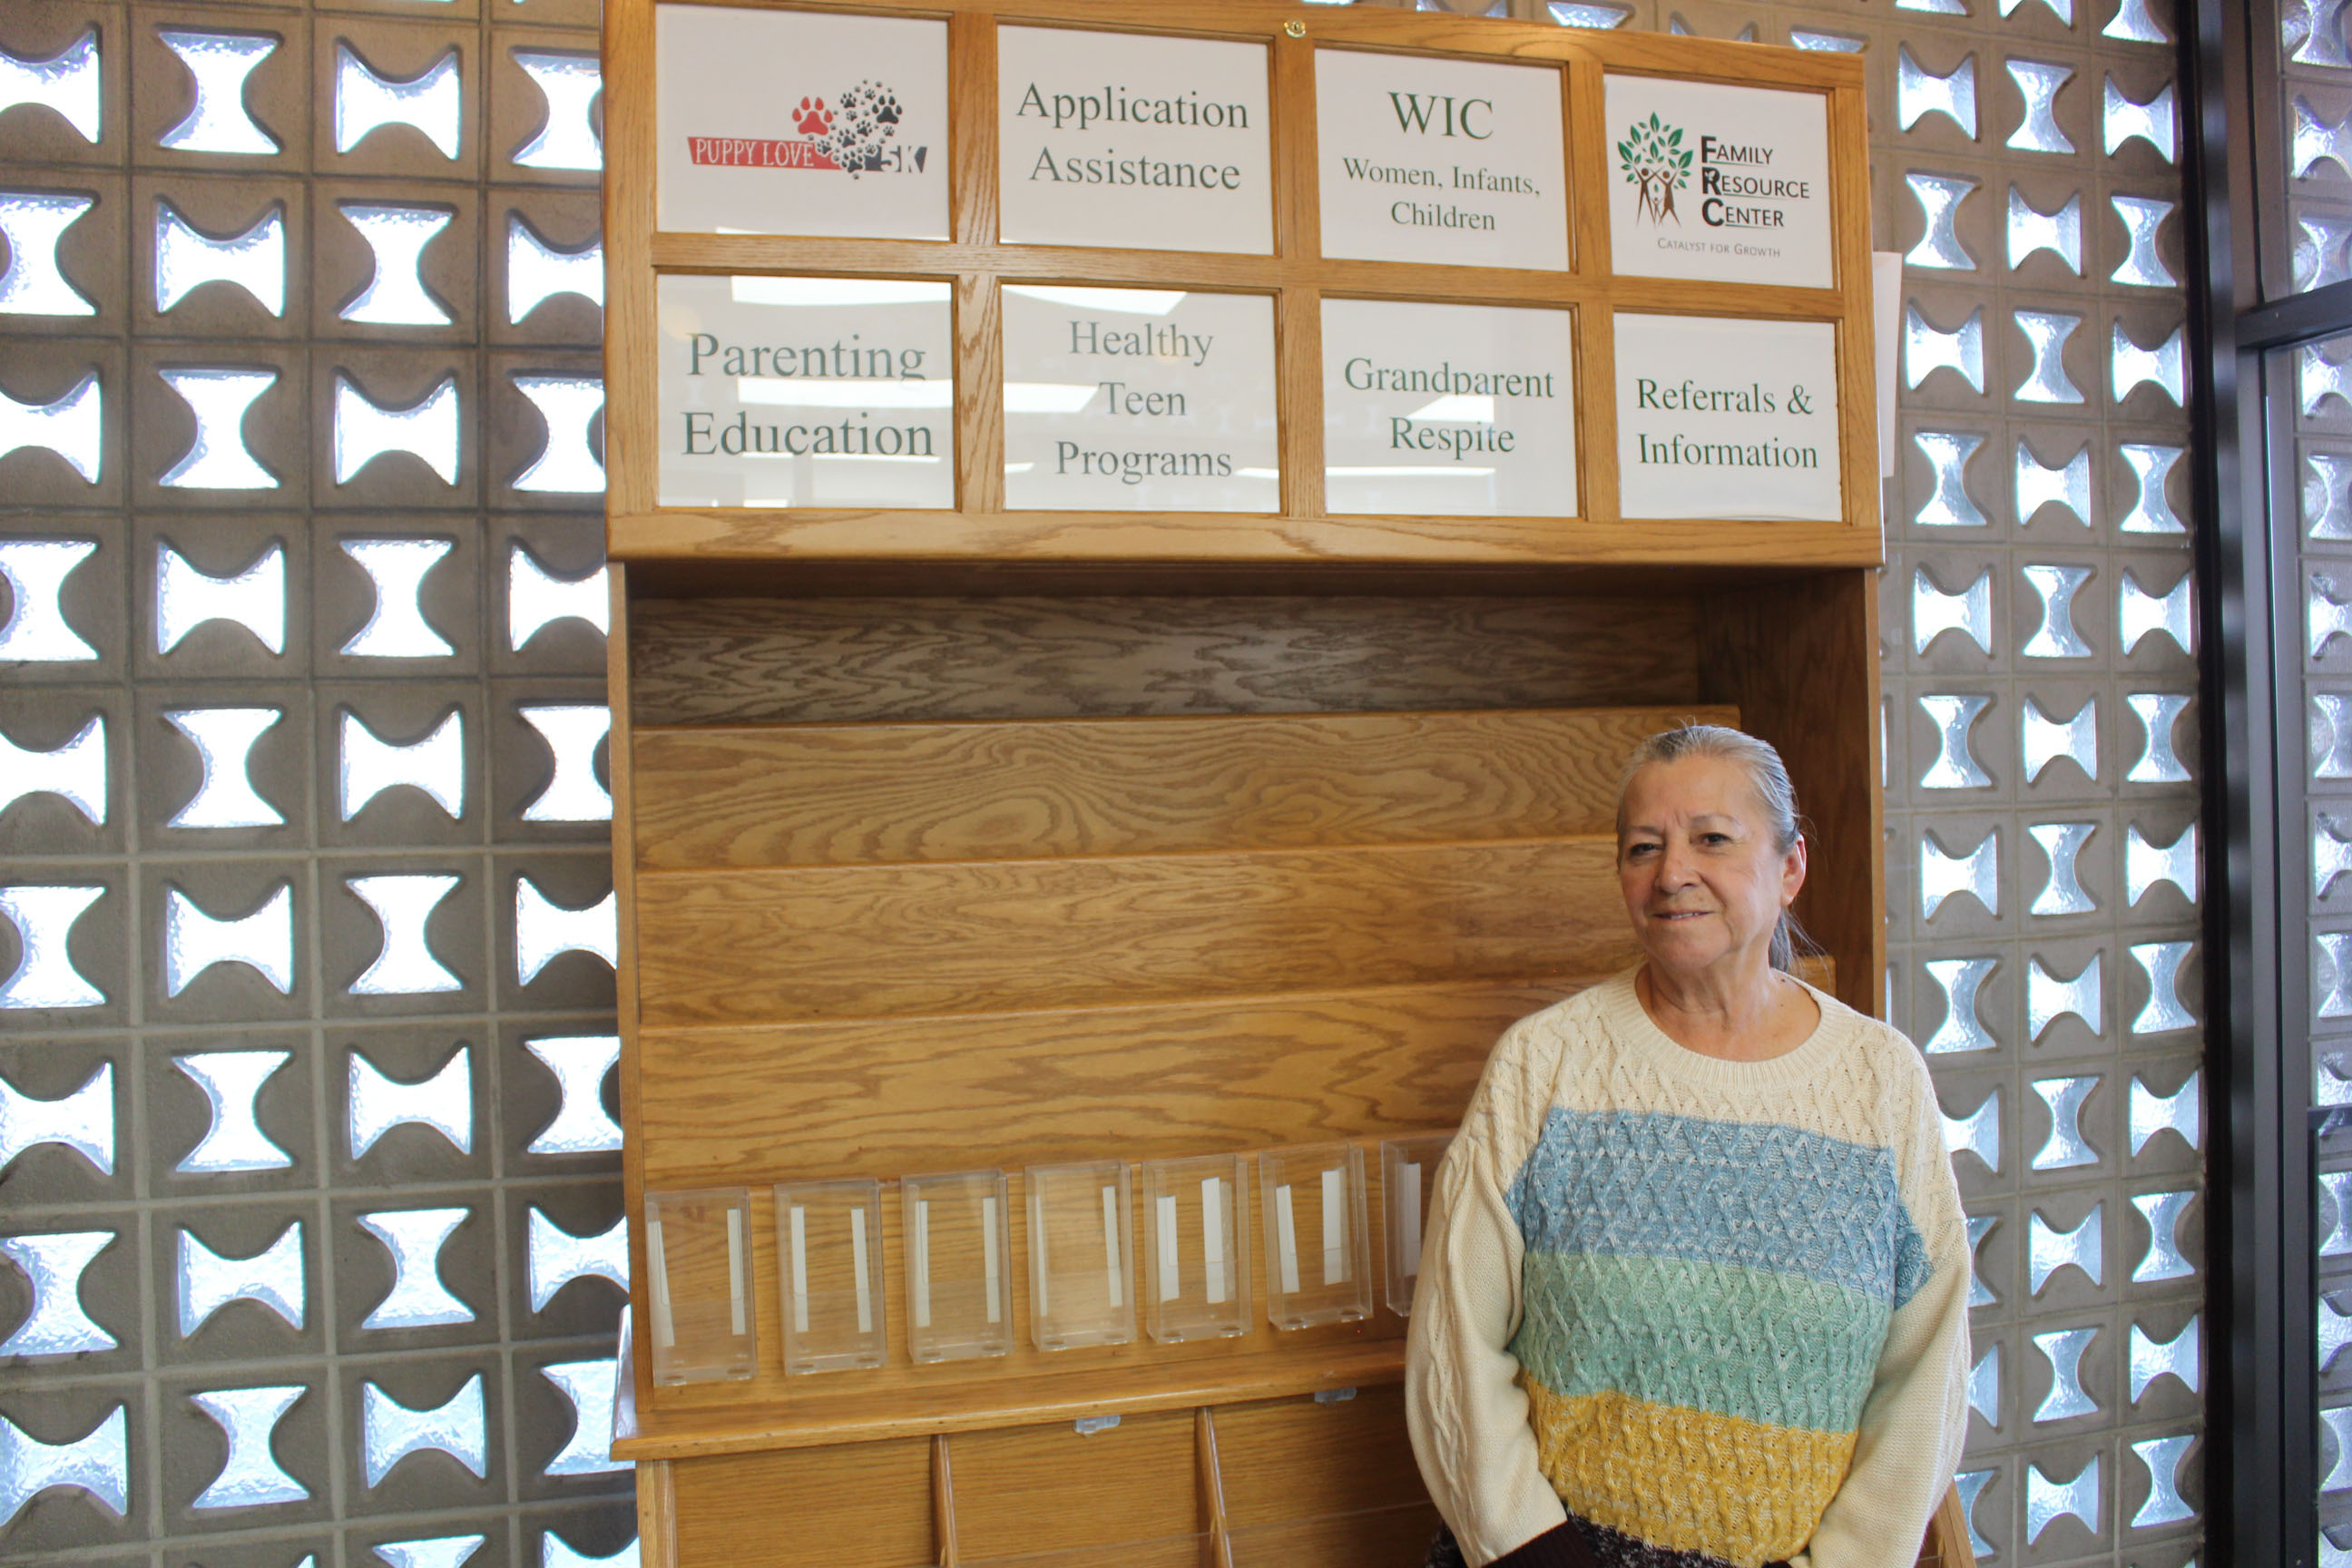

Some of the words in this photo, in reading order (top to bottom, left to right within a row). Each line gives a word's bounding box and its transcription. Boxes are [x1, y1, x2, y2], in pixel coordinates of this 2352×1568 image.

[1017, 83, 1250, 130] Application
[1388, 92, 1494, 140] WIC
[695, 138, 756, 165] PUPPY
[762, 142, 815, 167] LOVE
[881, 146, 924, 173] 5K
[1029, 146, 1241, 190] Assistance
[1701, 135, 1774, 166] FAMILY
[1343, 156, 1443, 190] Women,
[1453, 166, 1541, 196] Infants,
[1702, 168, 1810, 199] RESOURCE
[1391, 201, 1495, 231] Children
[1702, 198, 1784, 228] CENTER
[1657, 237, 1705, 253] CATALYST
[1710, 243, 1730, 254] FOR
[1733, 243, 1780, 258] GROWTH
[686, 332, 926, 381] Parenting
[1068, 320, 1214, 367] Healthy
[1345, 358, 1554, 398] Grandparent
[1636, 378, 1776, 414] Referrals
[1787, 385, 1814, 415] &
[1099, 381, 1187, 416] Teen
[681, 411, 933, 456] Education
[1389, 416, 1516, 460] Respite
[1638, 433, 1818, 468] Information
[1054, 441, 1232, 485] Programs
